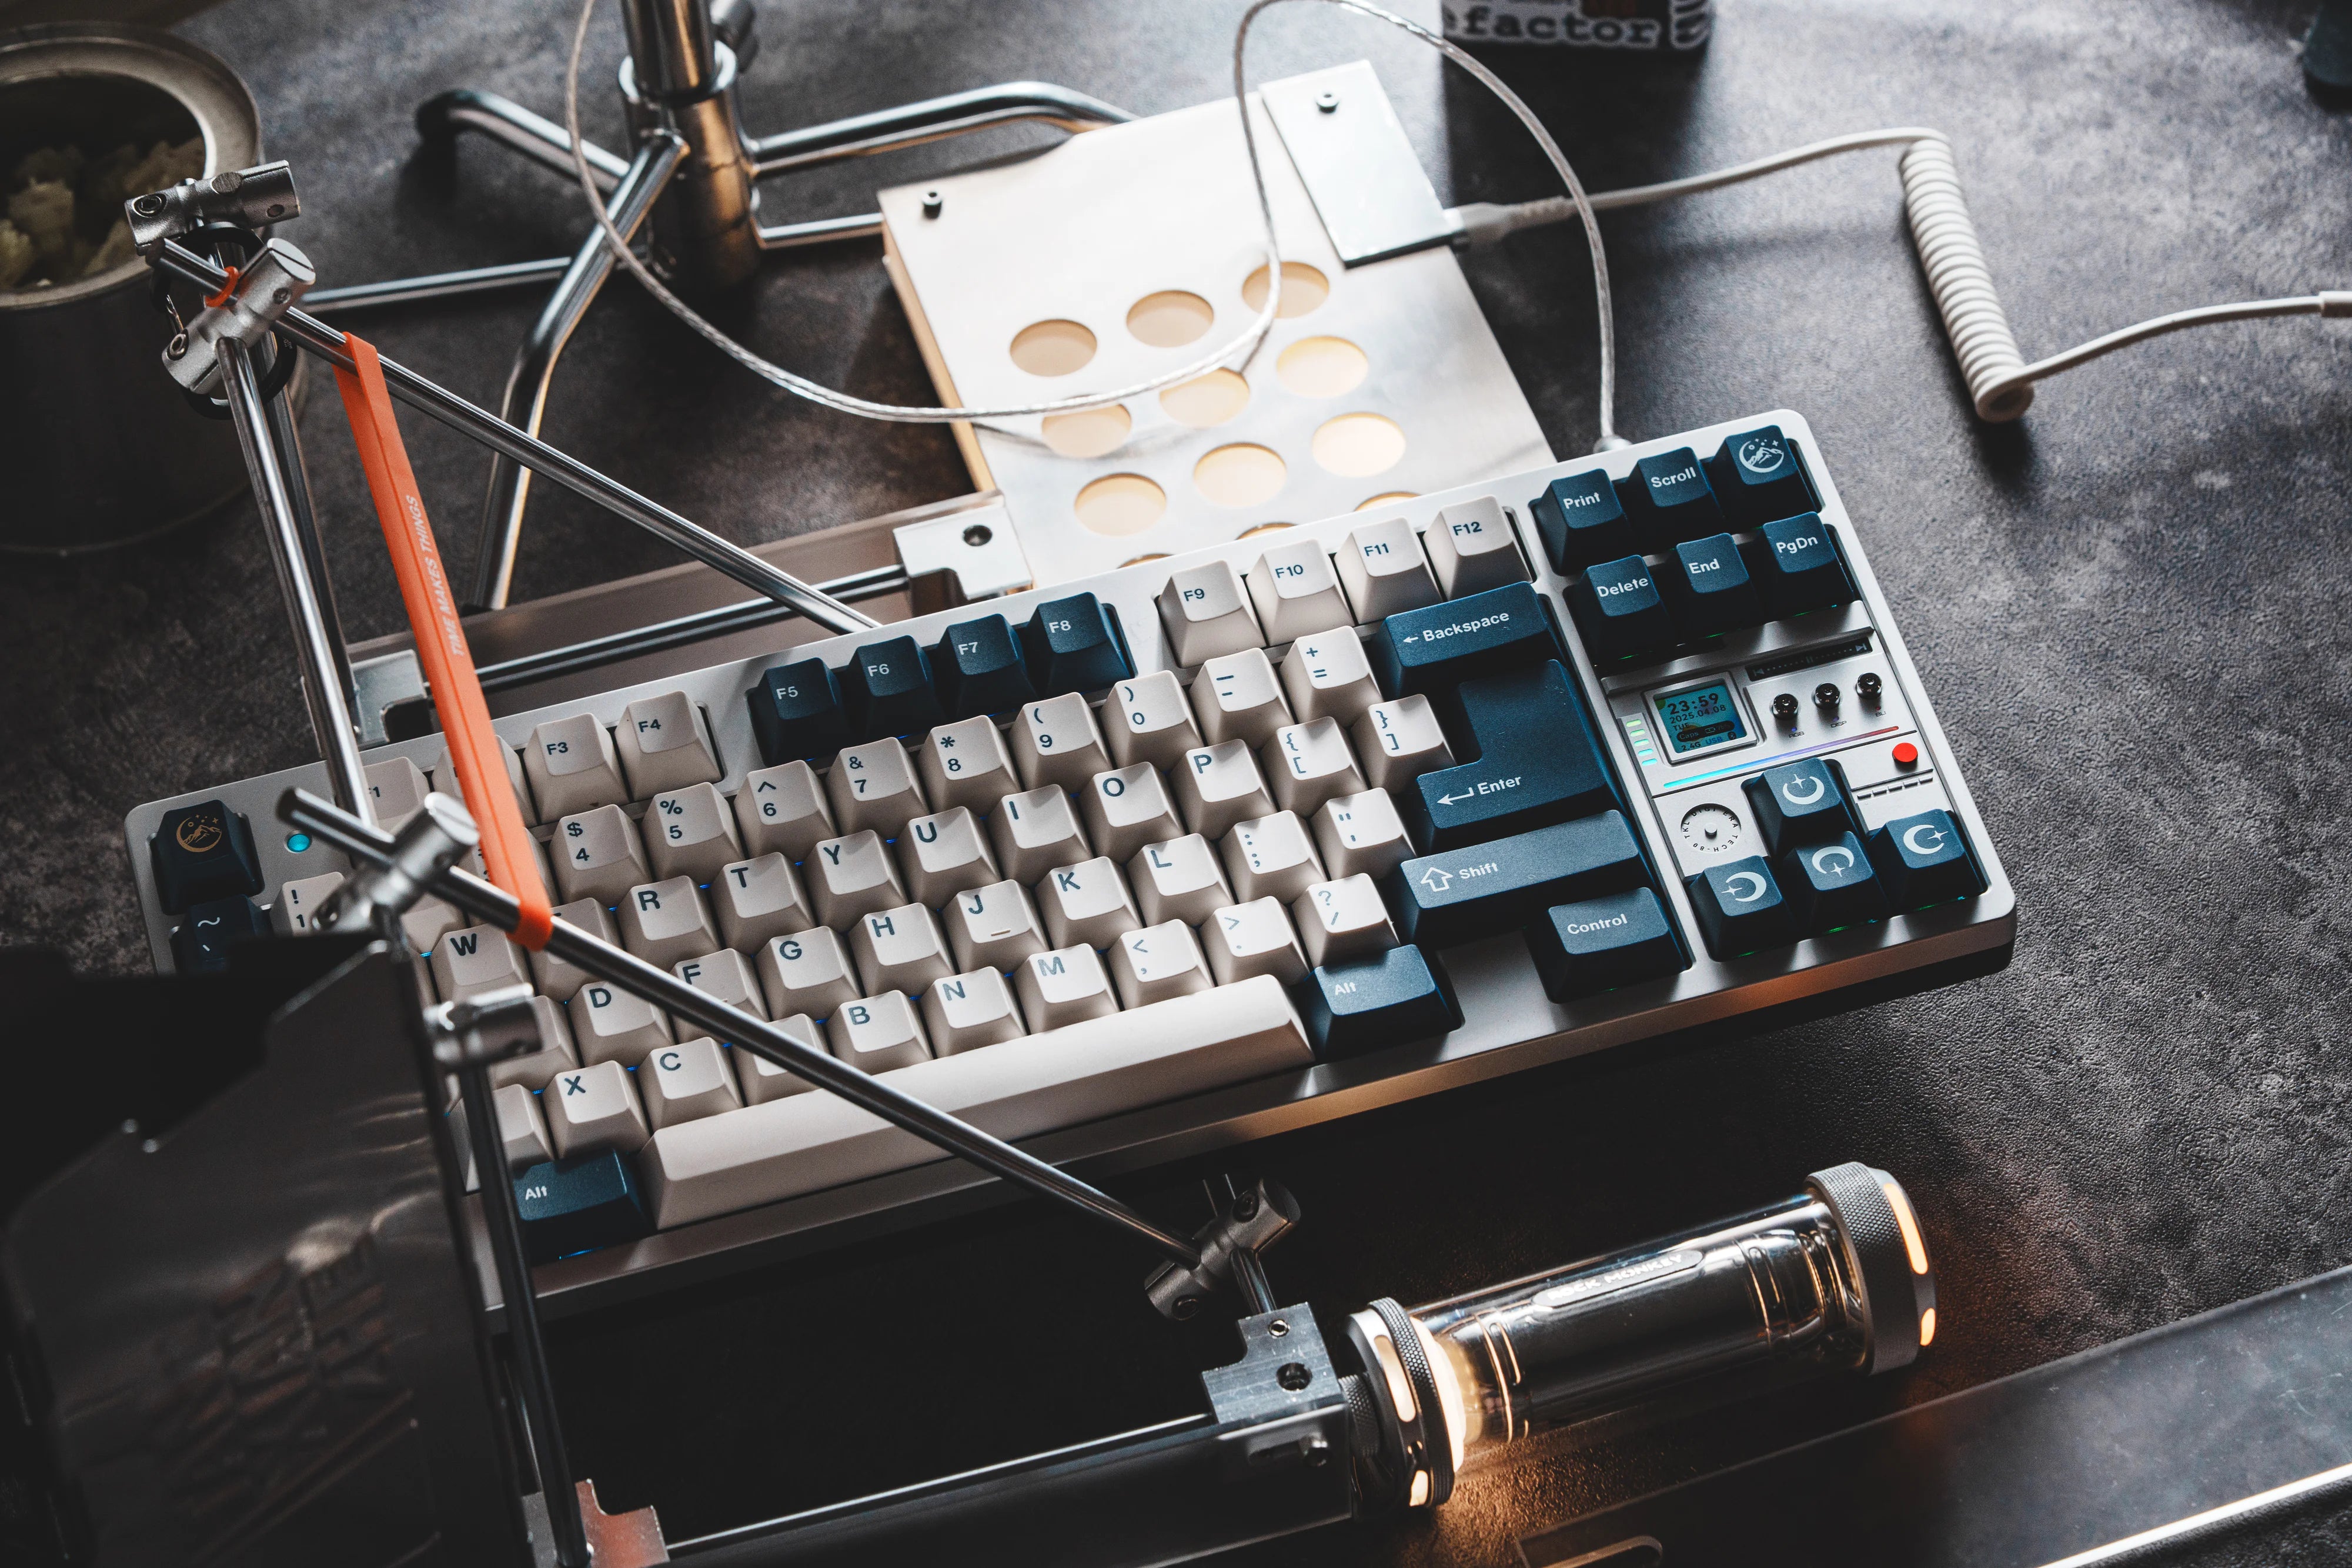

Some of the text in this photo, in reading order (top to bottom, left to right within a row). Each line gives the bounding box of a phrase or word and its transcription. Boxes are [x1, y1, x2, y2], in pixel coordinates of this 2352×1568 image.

[1651, 467, 1696, 487] Scroll
[1563, 493, 1600, 509] Print
[1453, 521, 1482, 536] F12
[1364, 543, 1389, 556] F11
[1776, 534, 1818, 553] PgDn
[406, 494, 465, 656] TIME MAKES THINGS
[1275, 565, 1303, 578] F10
[1689, 559, 1719, 573] End
[1184, 589, 1204, 601] F9
[1597, 579, 1648, 597] Delete
[1049, 620, 1071, 633] F8
[1422, 611, 1509, 642] Backspace
[958, 642, 978, 655] F7
[868, 664, 889, 677] F6
[776, 686, 798, 699] F5
[1668, 693, 1718, 715] 23:59
[1669, 704, 1726, 724] 2025.04.08
[639, 719, 662, 732] F4
[1673, 722, 1689, 731] TUE
[1040, 735, 1052, 747] 9
[1679, 731, 1699, 740] Caps
[1682, 737, 1722, 750] 2.4G USB
[547, 742, 568, 755] F3
[948, 758, 961, 771] 8
[1193, 755, 1212, 774] P
[854, 780, 866, 793] 7
[1103, 778, 1124, 797] O
[1478, 775, 1521, 794] Enter
[763, 803, 776, 816] 6
[1691, 808, 1716, 817] DIGI
[1723, 811, 1738, 828] ERA
[670, 825, 682, 839] 5
[916, 822, 937, 842] U
[1693, 835, 1738, 852] TECH-80
[576, 848, 590, 861] 4
[823, 845, 840, 865] Y
[1151, 850, 1172, 868] L
[730, 867, 749, 888] T
[1459, 863, 1498, 878] Shift
[1058, 872, 1080, 892] K
[637, 891, 660, 911] R
[968, 895, 983, 914] J
[296, 914, 305, 928] 1
[872, 917, 894, 937] H
[1568, 914, 1627, 934] Control
[450, 933, 477, 956] W
[780, 941, 802, 959] G
[683, 964, 700, 985] F
[1038, 957, 1065, 978] M
[943, 981, 965, 1001] N
[1333, 981, 1356, 995] Alt
[589, 987, 612, 1008] D
[848, 1007, 870, 1025] B
[660, 1053, 681, 1071] C
[564, 1076, 586, 1095] X
[526, 1186, 547, 1200] Alt
[1604, 1254, 1682, 1283] MONKEY
